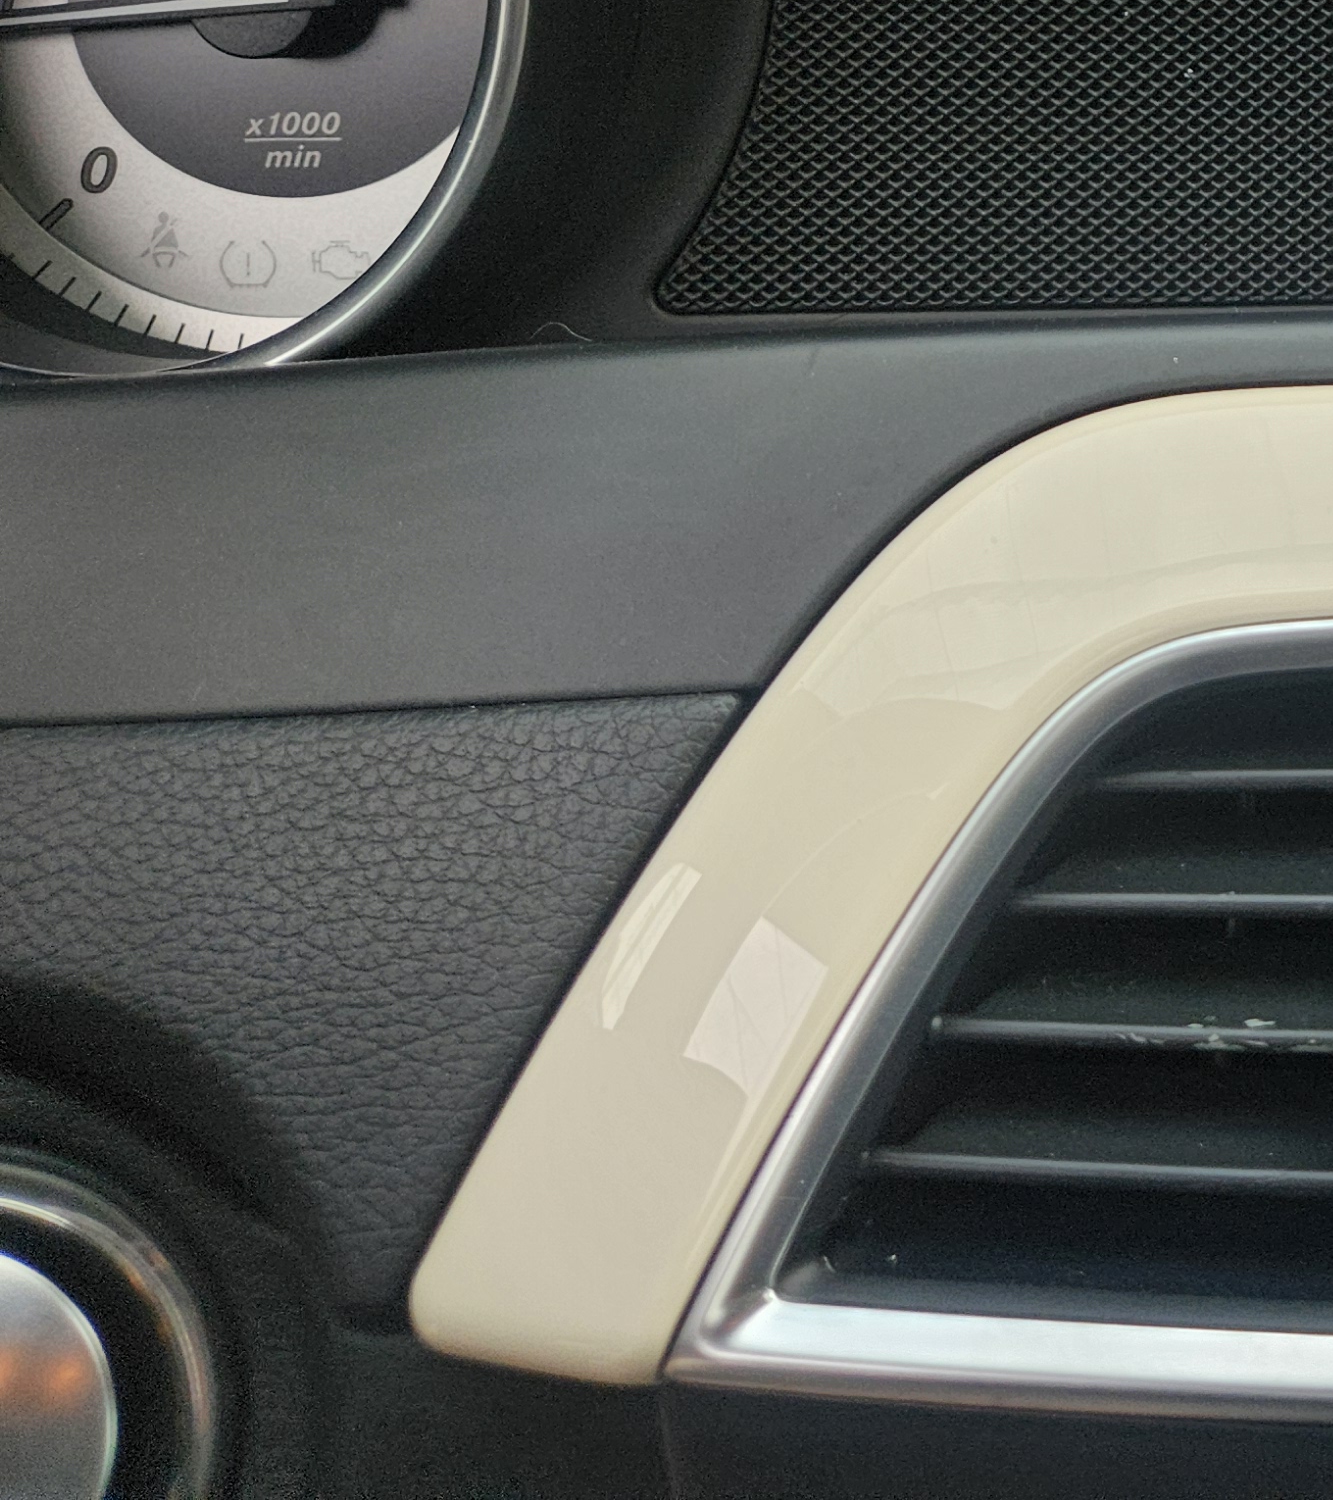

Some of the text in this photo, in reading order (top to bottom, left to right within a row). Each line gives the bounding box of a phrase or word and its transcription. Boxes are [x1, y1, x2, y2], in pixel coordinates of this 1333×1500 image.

[244, 110, 342, 139] x1000
[79, 146, 118, 194] 0
[264, 146, 322, 170] min
